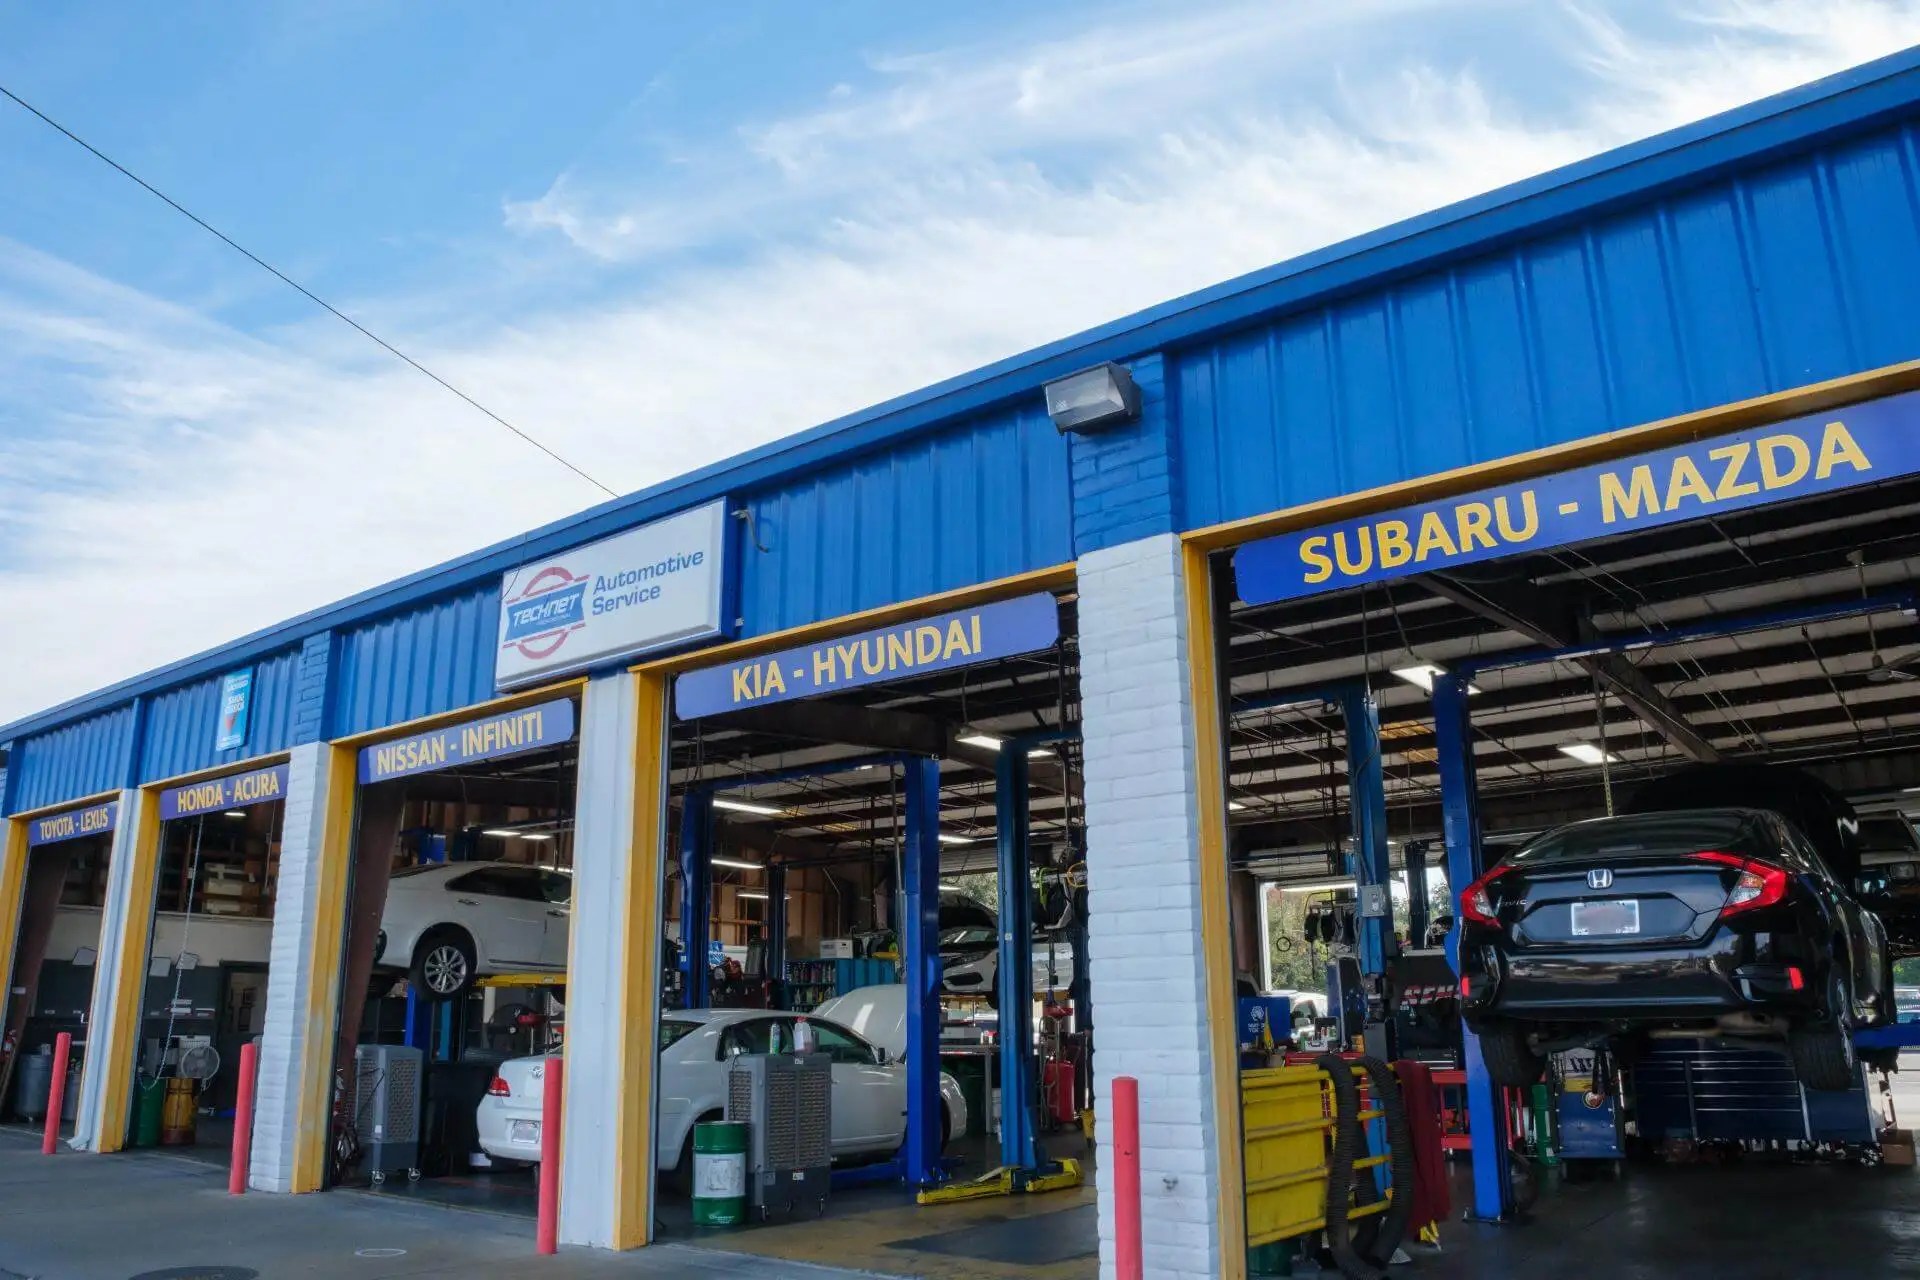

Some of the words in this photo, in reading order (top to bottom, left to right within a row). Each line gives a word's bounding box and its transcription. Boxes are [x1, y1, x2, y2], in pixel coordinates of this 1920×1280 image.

[1299, 490, 1538, 584] SUBARU
[1599, 420, 1873, 524] MAZDA
[593, 551, 704, 595] Automotive
[592, 585, 661, 616] Service
[732, 660, 786, 702] KIA
[813, 615, 982, 686] HYUNDAI
[377, 735, 446, 776] NISSAN
[462, 711, 543, 757] INFINITI
[177, 784, 224, 813] HONDA
[233, 771, 279, 802] ACURA
[40, 816, 75, 841] TOYOTA
[80, 807, 109, 832] LEXUS
